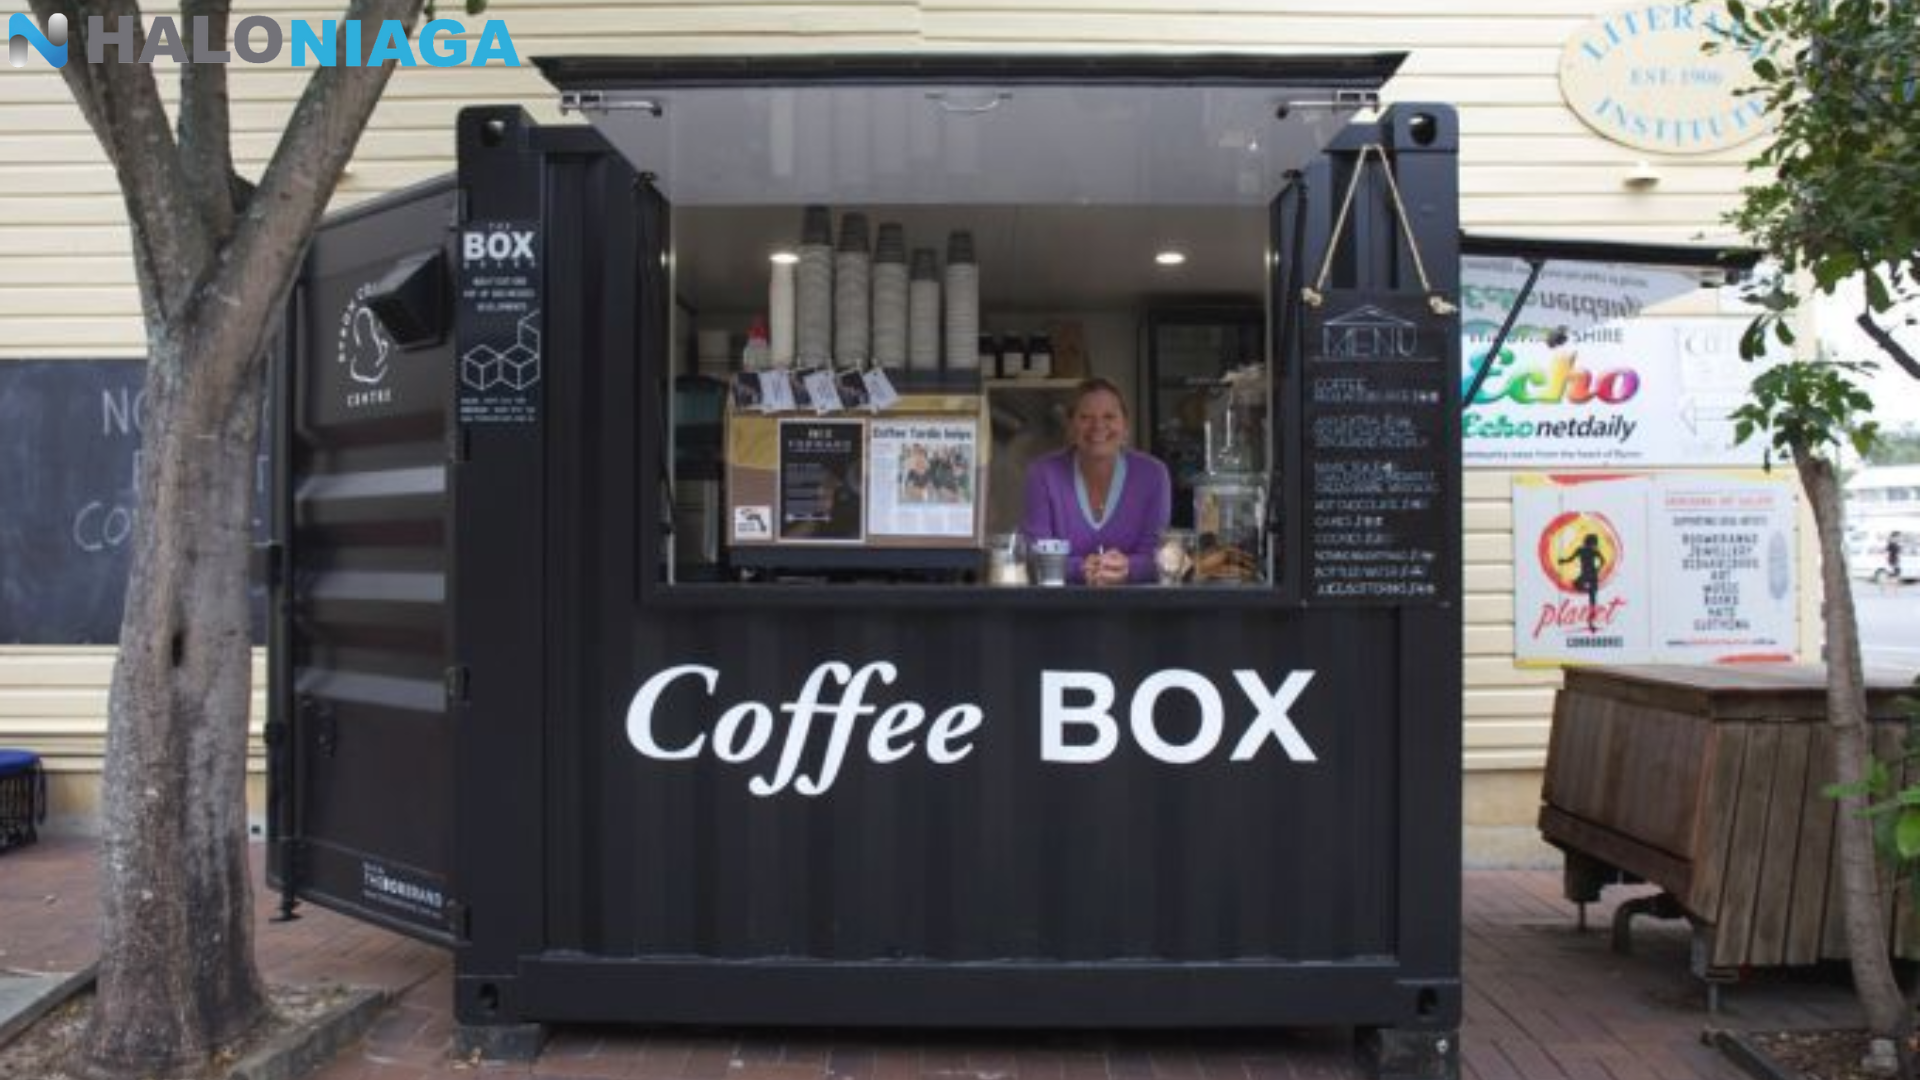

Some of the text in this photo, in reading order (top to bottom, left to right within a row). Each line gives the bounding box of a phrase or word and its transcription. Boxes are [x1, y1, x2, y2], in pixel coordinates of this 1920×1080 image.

[463, 231, 535, 260] BOX
[1572, 327, 1624, 343] SHIRE
[1461, 350, 1640, 404] Echo
[625, 661, 1318, 796] Coffee BOX
